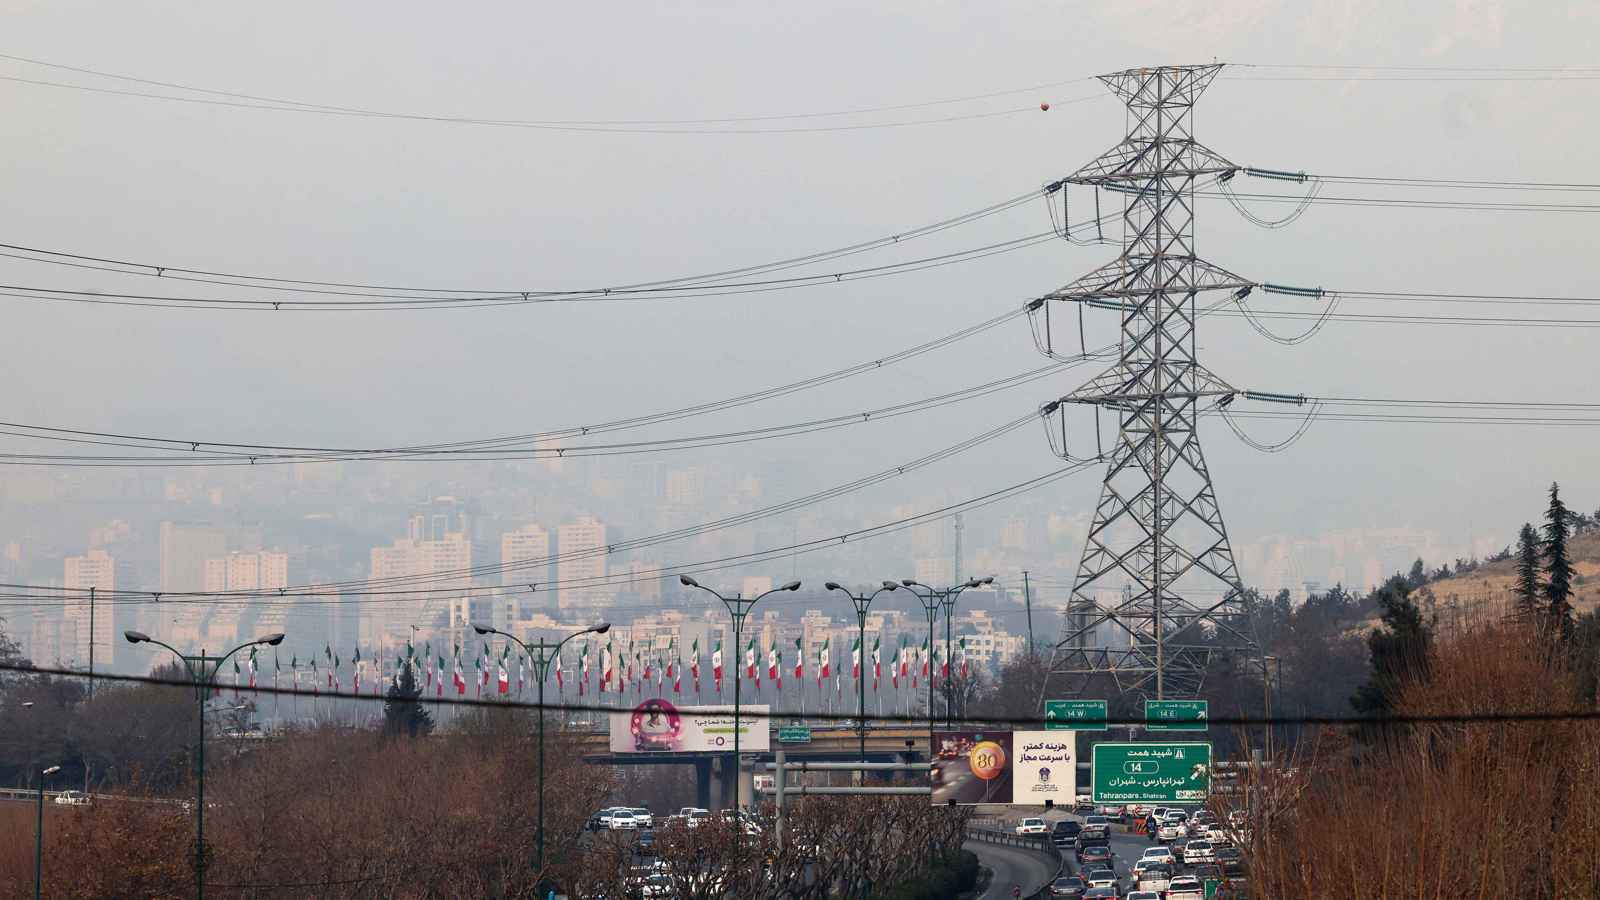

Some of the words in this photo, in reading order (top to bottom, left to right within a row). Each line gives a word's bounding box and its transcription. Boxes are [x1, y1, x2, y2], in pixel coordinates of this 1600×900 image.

[1045, 743, 1067, 752] هزینه
[1127, 748, 1150, 757] همت
[1038, 754, 1063, 763] سرعت
[1064, 754, 1070, 762] با
[1151, 748, 1172, 759] شهید
[978, 753, 998, 768] 80
[1018, 754, 1038, 764] مجاز
[1130, 762, 1142, 772] 14
[1108, 776, 1136, 787] شهران
[1143, 776, 1184, 788] تهرانپارس
[1099, 792, 1138, 802] Tehranpars
